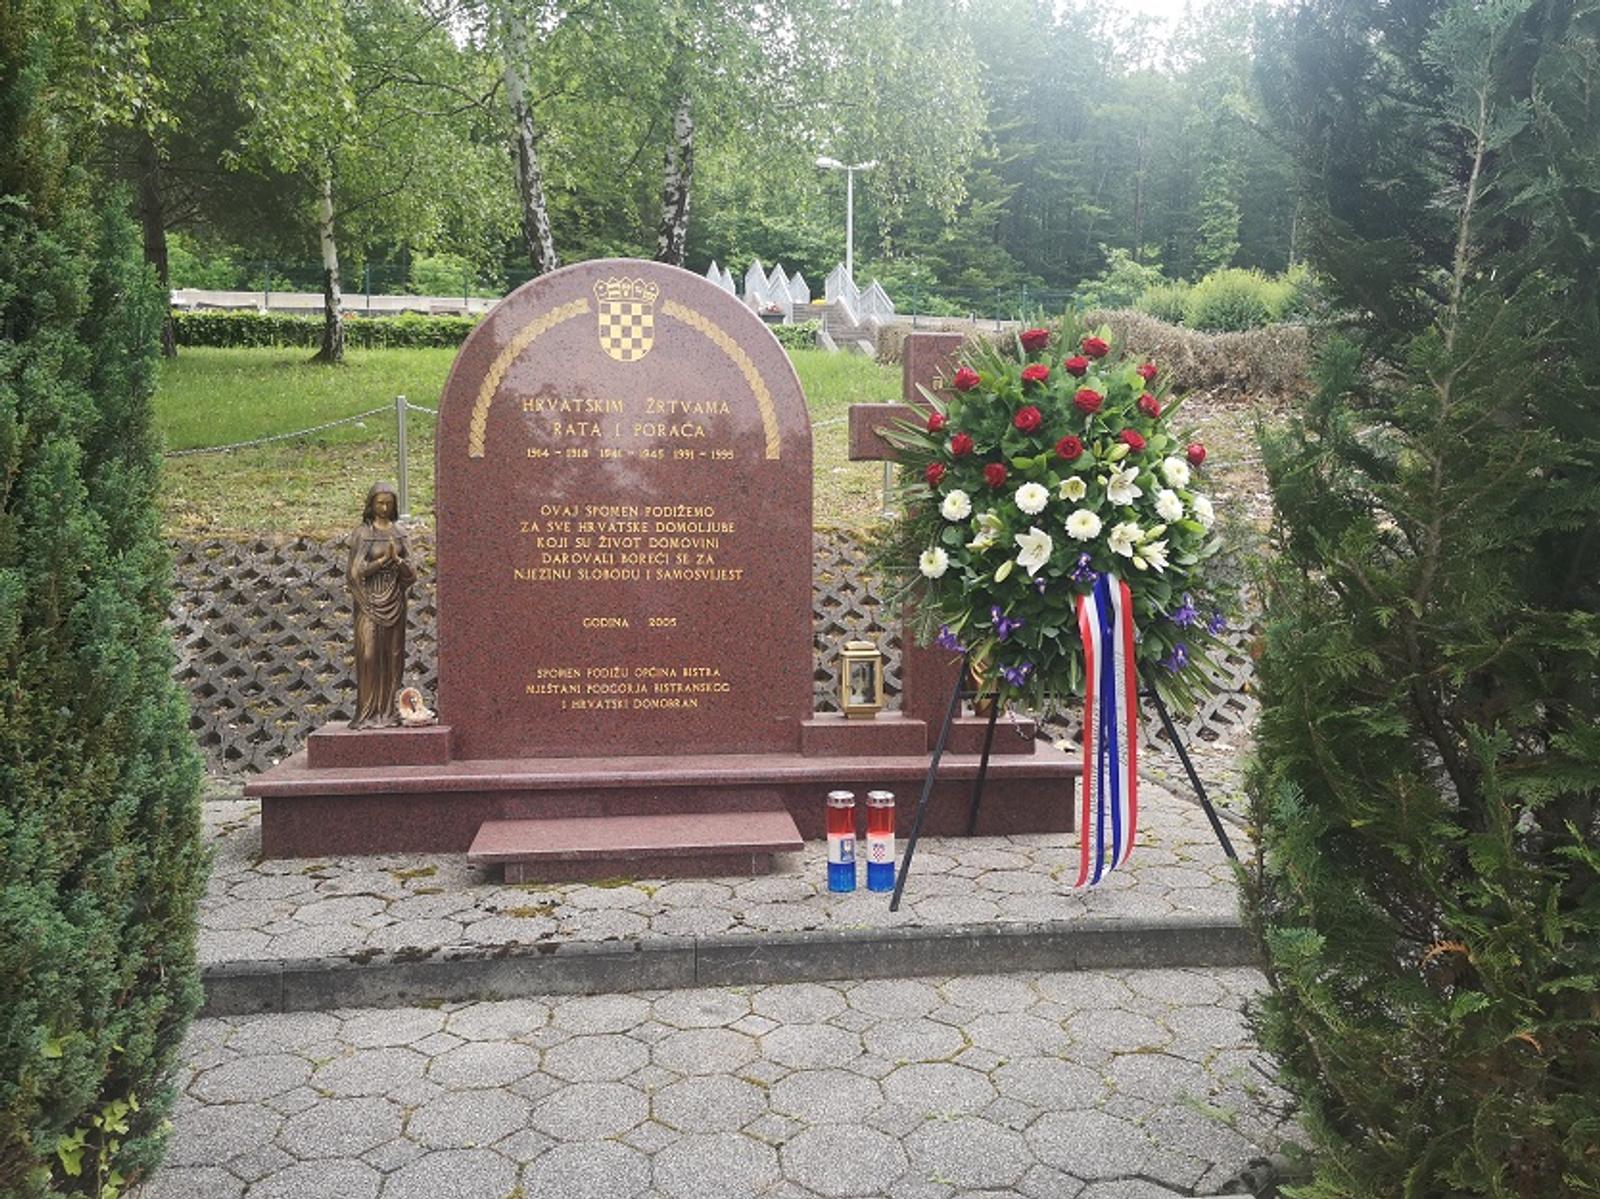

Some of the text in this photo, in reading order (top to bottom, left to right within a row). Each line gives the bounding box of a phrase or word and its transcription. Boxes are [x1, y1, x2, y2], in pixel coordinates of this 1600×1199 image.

[522, 398, 624, 413] HRVATSKIM
[552, 421, 602, 437] RATA
[615, 422, 621, 437] I
[540, 504, 715, 518] OVAJ SPOMEN PODIŽEMO
[520, 521, 736, 533] ZA SVE HRVATSKE DOMOLJUBE
[536, 535, 719, 549] KOJI SU ŽIVOT DOMOVINI
[542, 552, 614, 564] DAROVALI
[675, 553, 690, 565] SE
[696, 553, 715, 565] ZA
[514, 568, 744, 581] NJEZINU SLOBODU I SAMOSVIJEST
[582, 617, 629, 628] GODINA
[537, 668, 581, 679] SPOMEN
[683, 667, 721, 677] BISTRA
[586, 683, 648, 694] PODGORJA
[654, 682, 730, 694] BISTRANSKOG
[561, 698, 699, 709] I HRVATSKI DOMOBRAN
